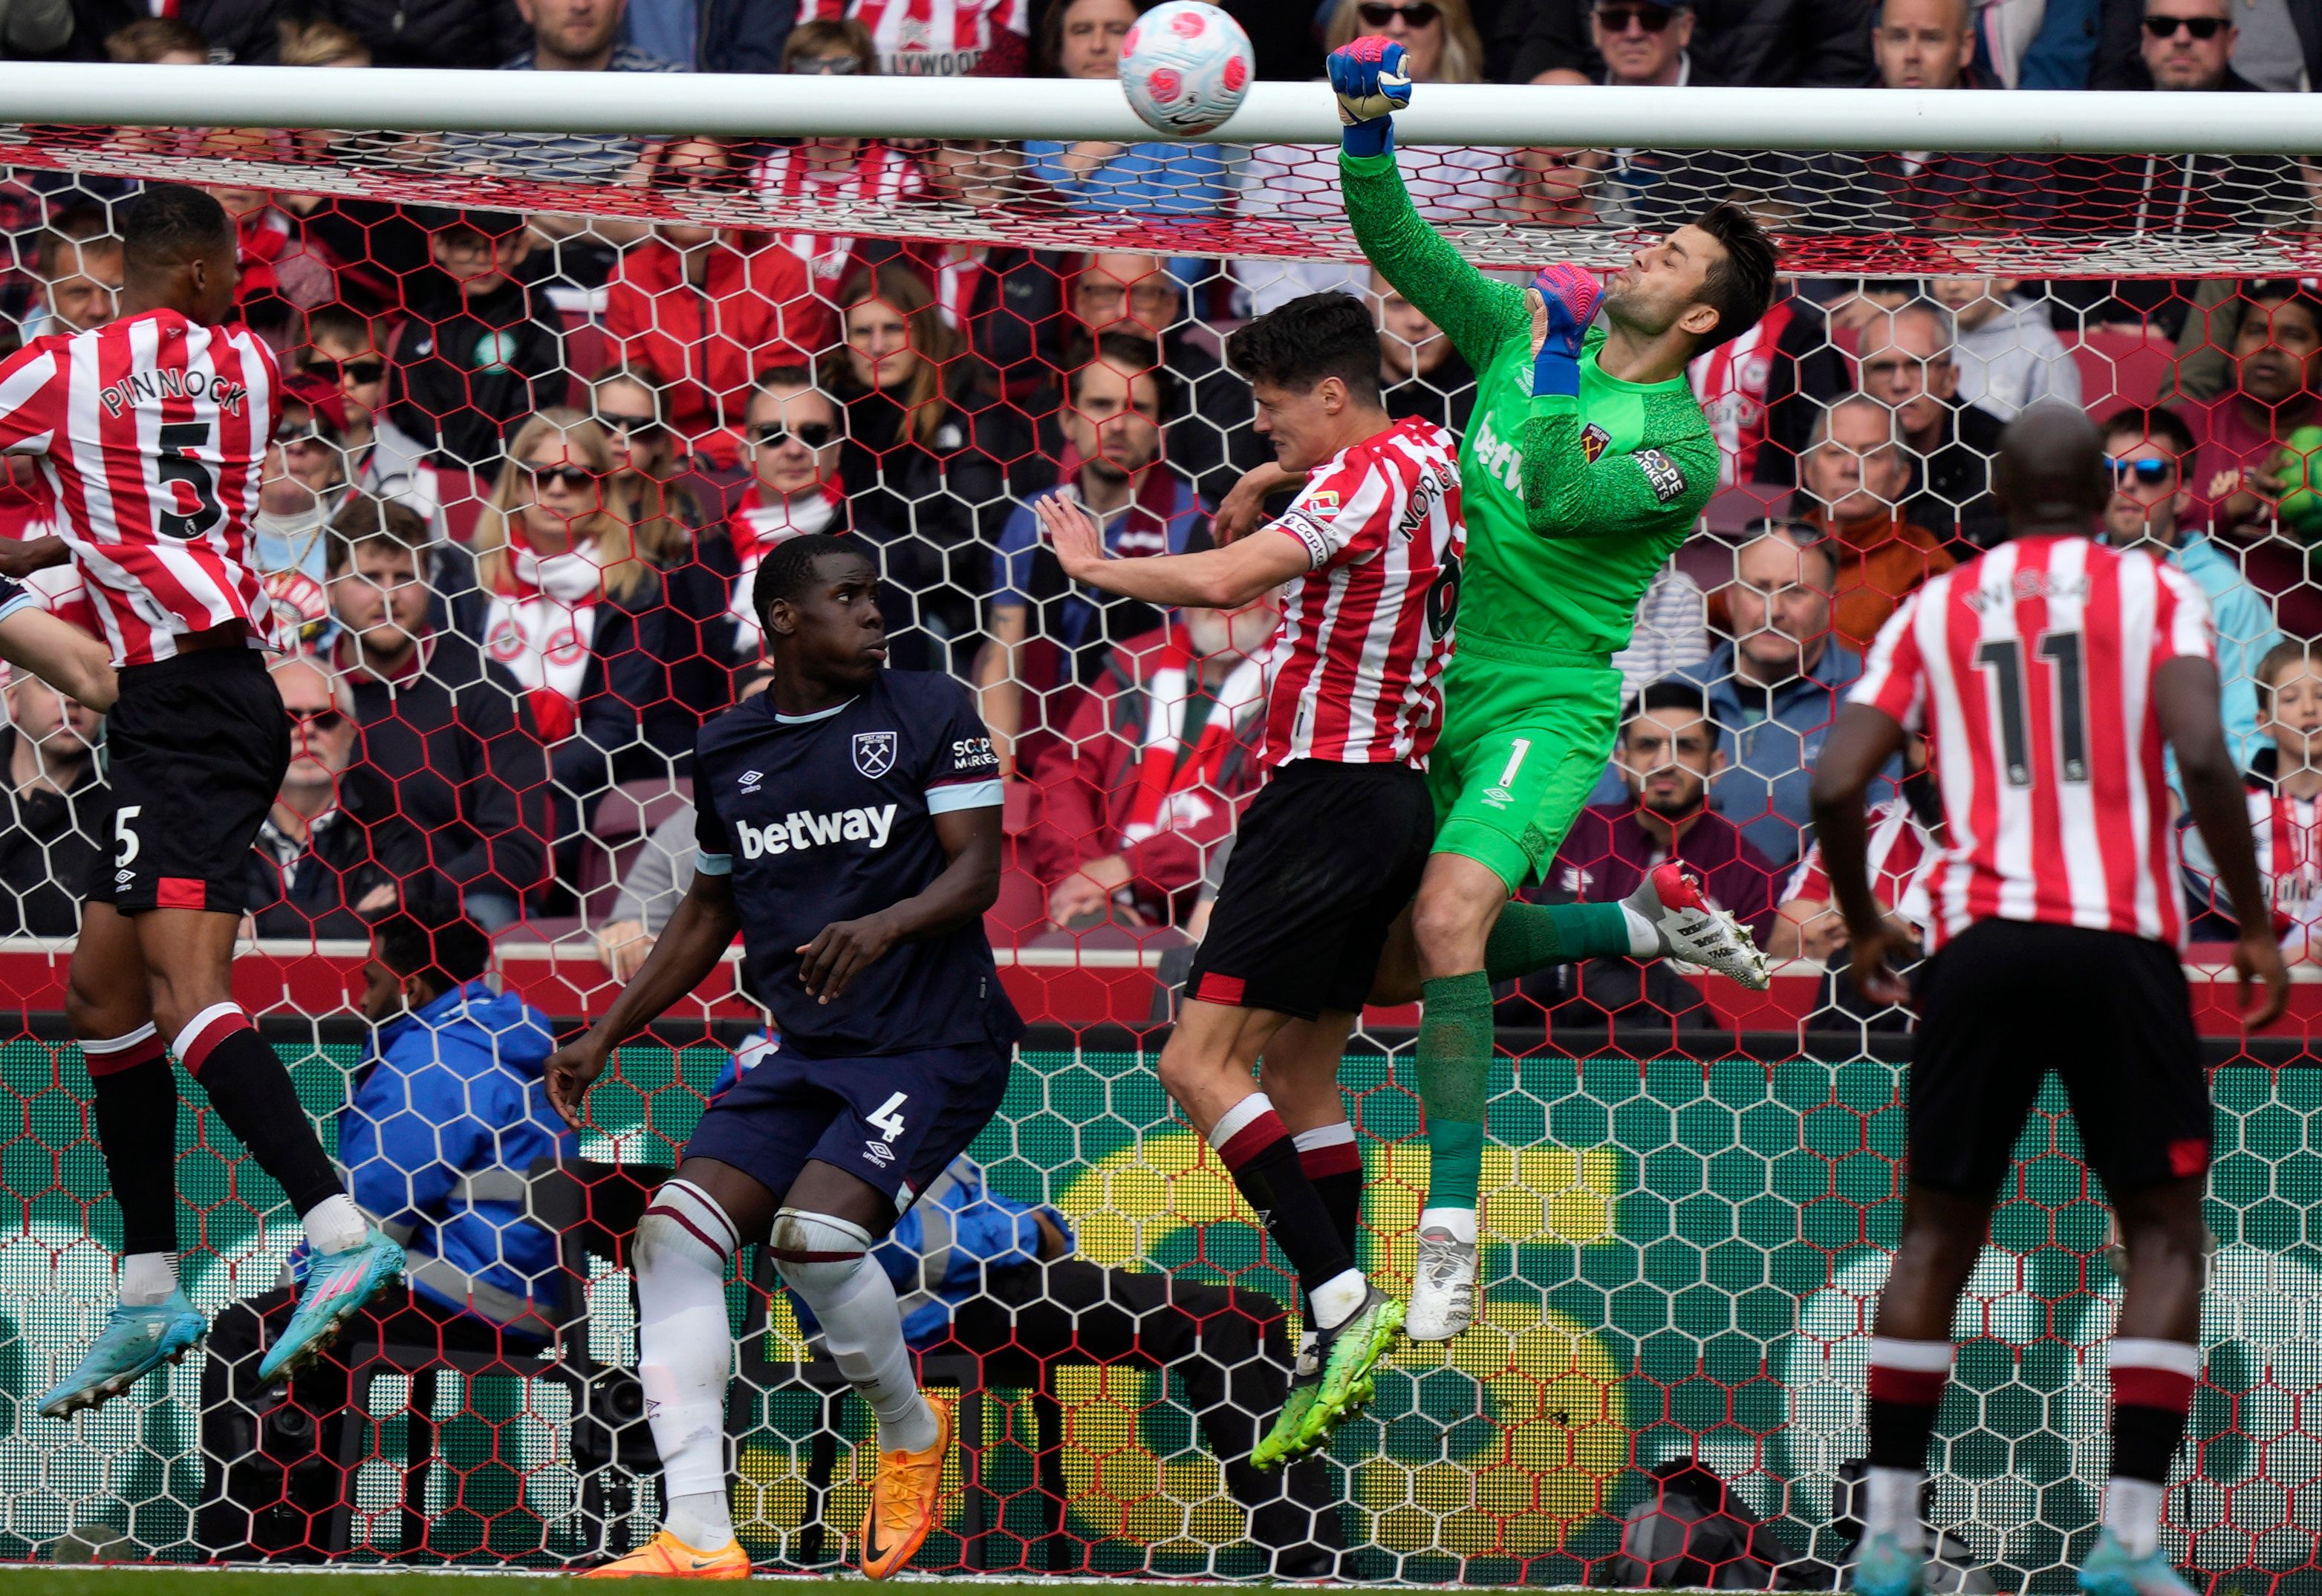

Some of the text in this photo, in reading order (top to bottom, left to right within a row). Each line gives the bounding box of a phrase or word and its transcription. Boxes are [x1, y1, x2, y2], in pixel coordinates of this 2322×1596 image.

[100, 368, 248, 418] PINNOCK
[157, 422, 222, 542] 5
[1970, 630, 2093, 787] 11
[1497, 737, 1532, 789] 1
[114, 805, 142, 868] 5
[735, 804, 898, 860] betway
[865, 1090, 908, 1143] 4
[862, 1151, 887, 1169] umbro
